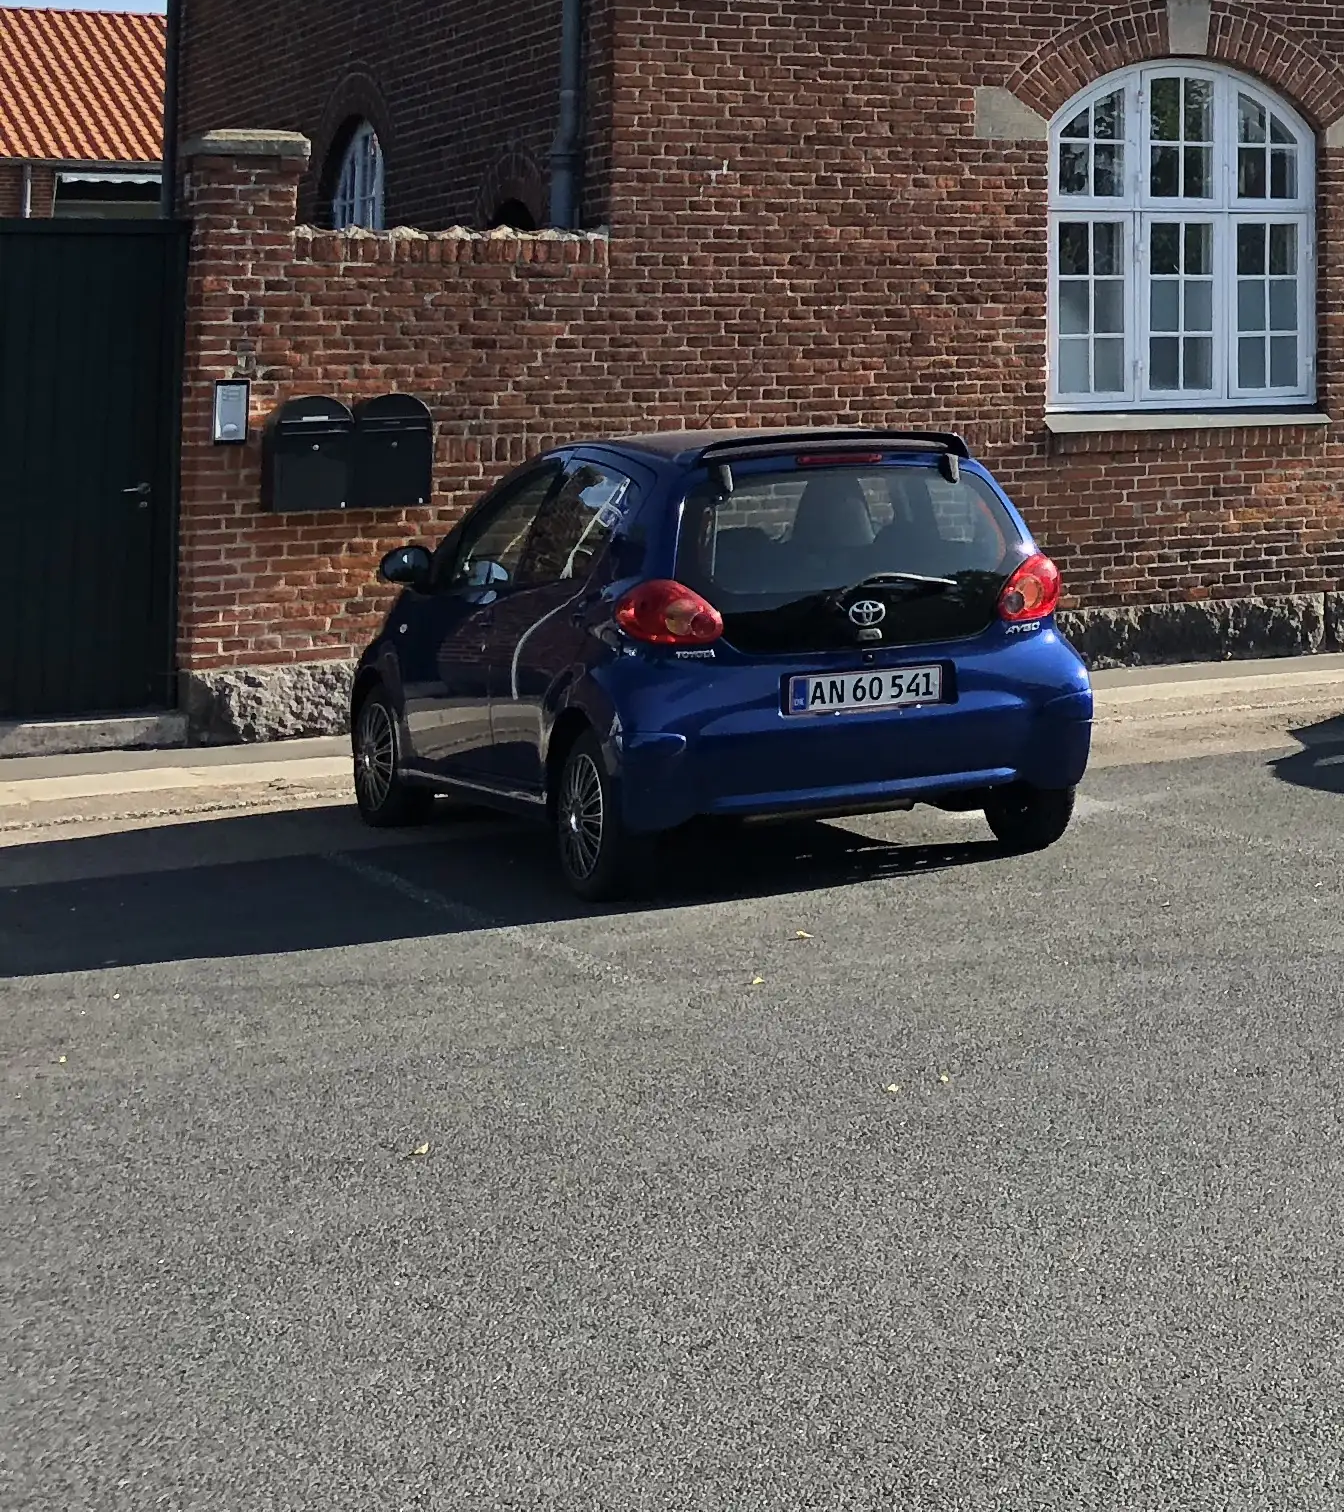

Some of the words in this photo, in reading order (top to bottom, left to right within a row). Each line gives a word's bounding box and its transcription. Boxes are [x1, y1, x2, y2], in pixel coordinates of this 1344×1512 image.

[675, 648, 716, 659] TOYOTA
[810, 678, 846, 706] AN
[852, 676, 883, 701] 60
[890, 672, 934, 699] 541
